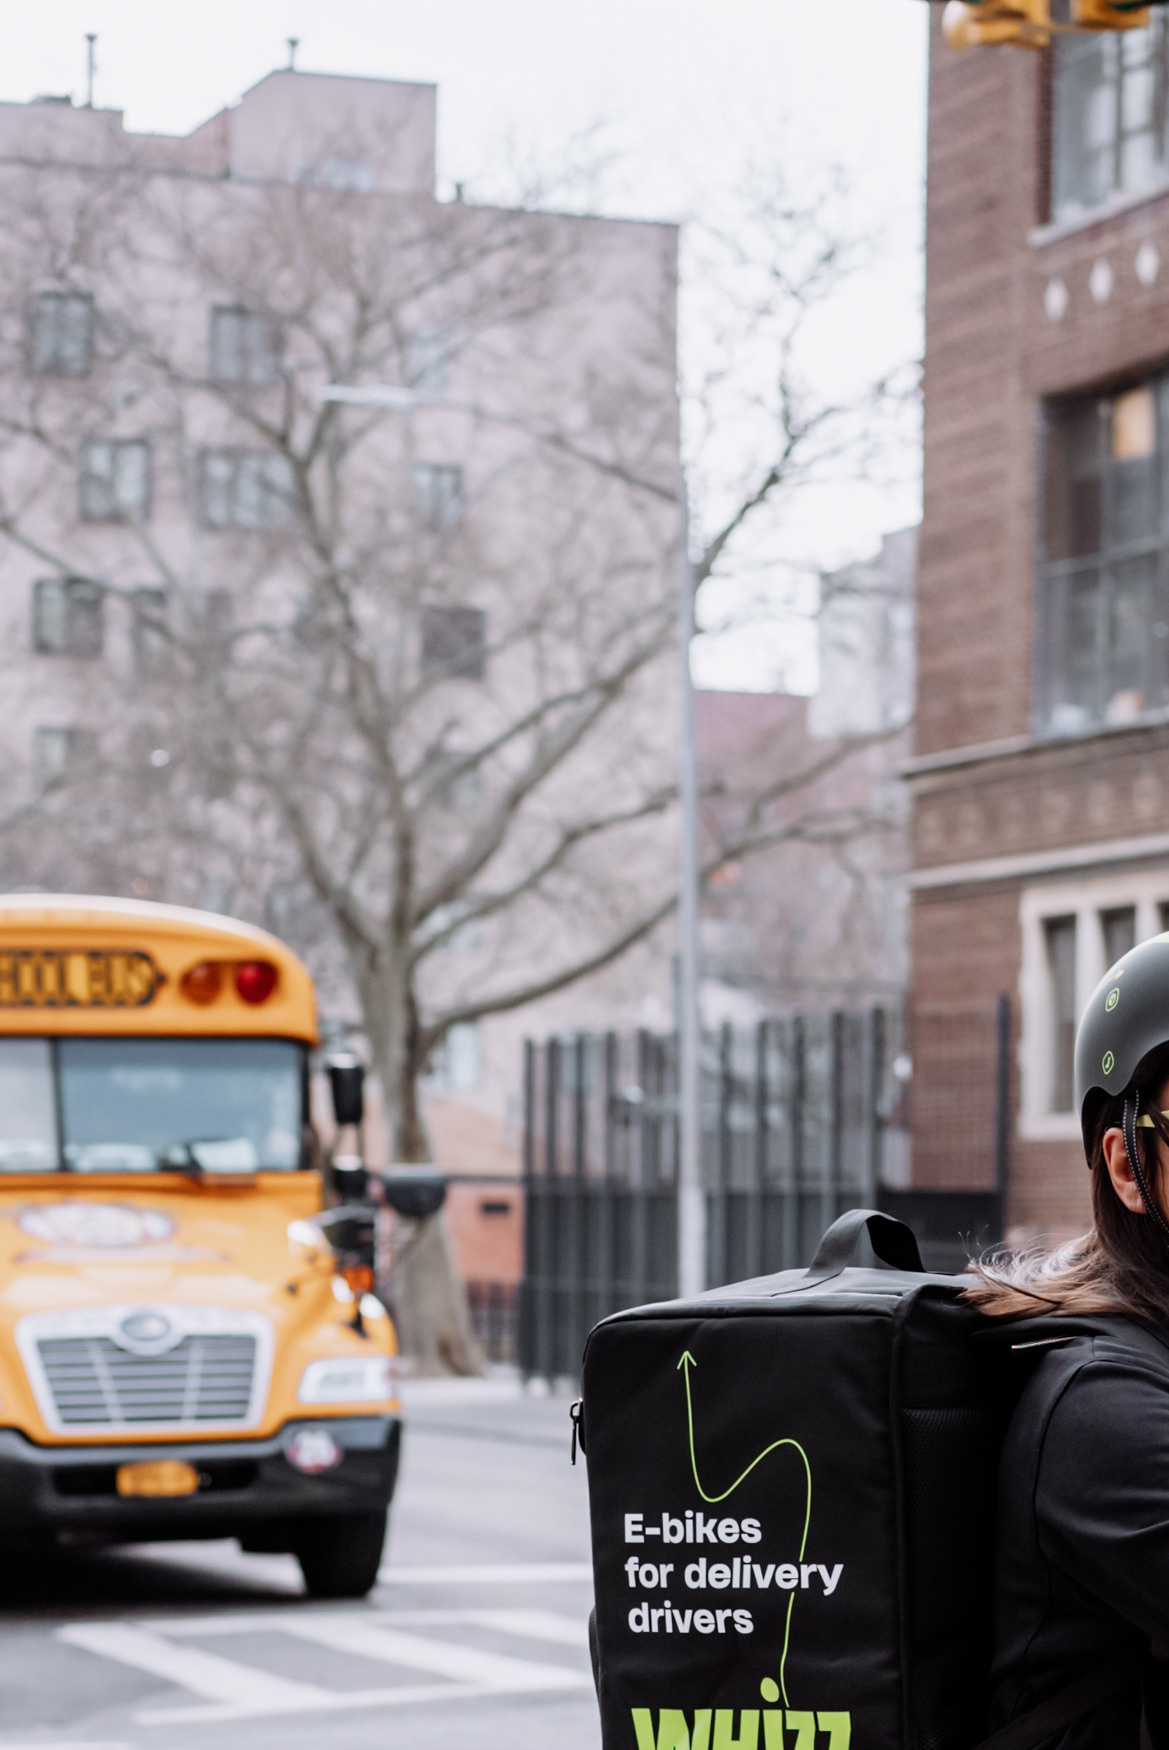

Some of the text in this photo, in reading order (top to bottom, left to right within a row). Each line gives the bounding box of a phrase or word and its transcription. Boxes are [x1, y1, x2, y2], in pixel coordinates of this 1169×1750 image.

[624, 1510, 762, 1544] E-bikes
[624, 1555, 844, 1596] for delivery
[628, 1600, 754, 1634] drivers
